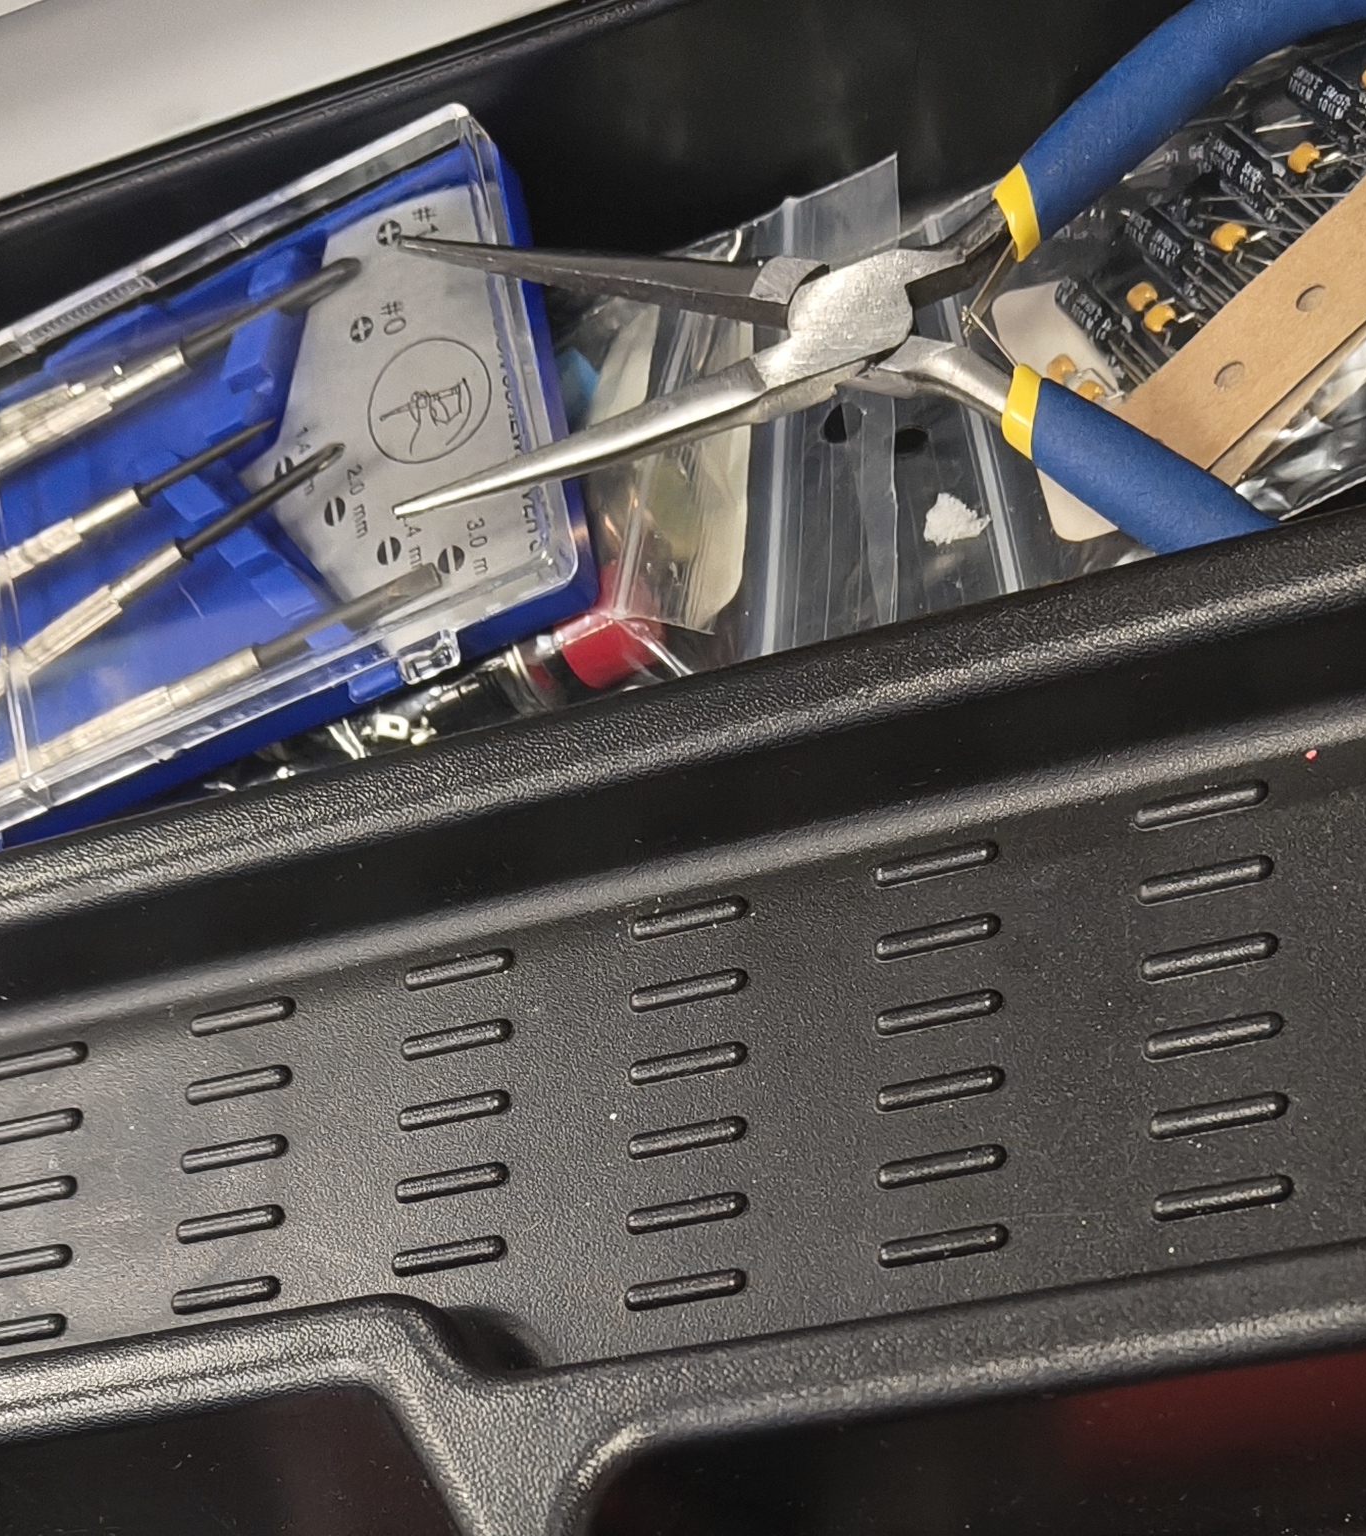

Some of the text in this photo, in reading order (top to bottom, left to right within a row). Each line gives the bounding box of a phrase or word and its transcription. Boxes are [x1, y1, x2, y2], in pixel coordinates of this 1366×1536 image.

[379, 300, 407, 335] #0
[346, 463, 369, 540] 2.0 mm
[466, 516, 489, 549] 3.0
